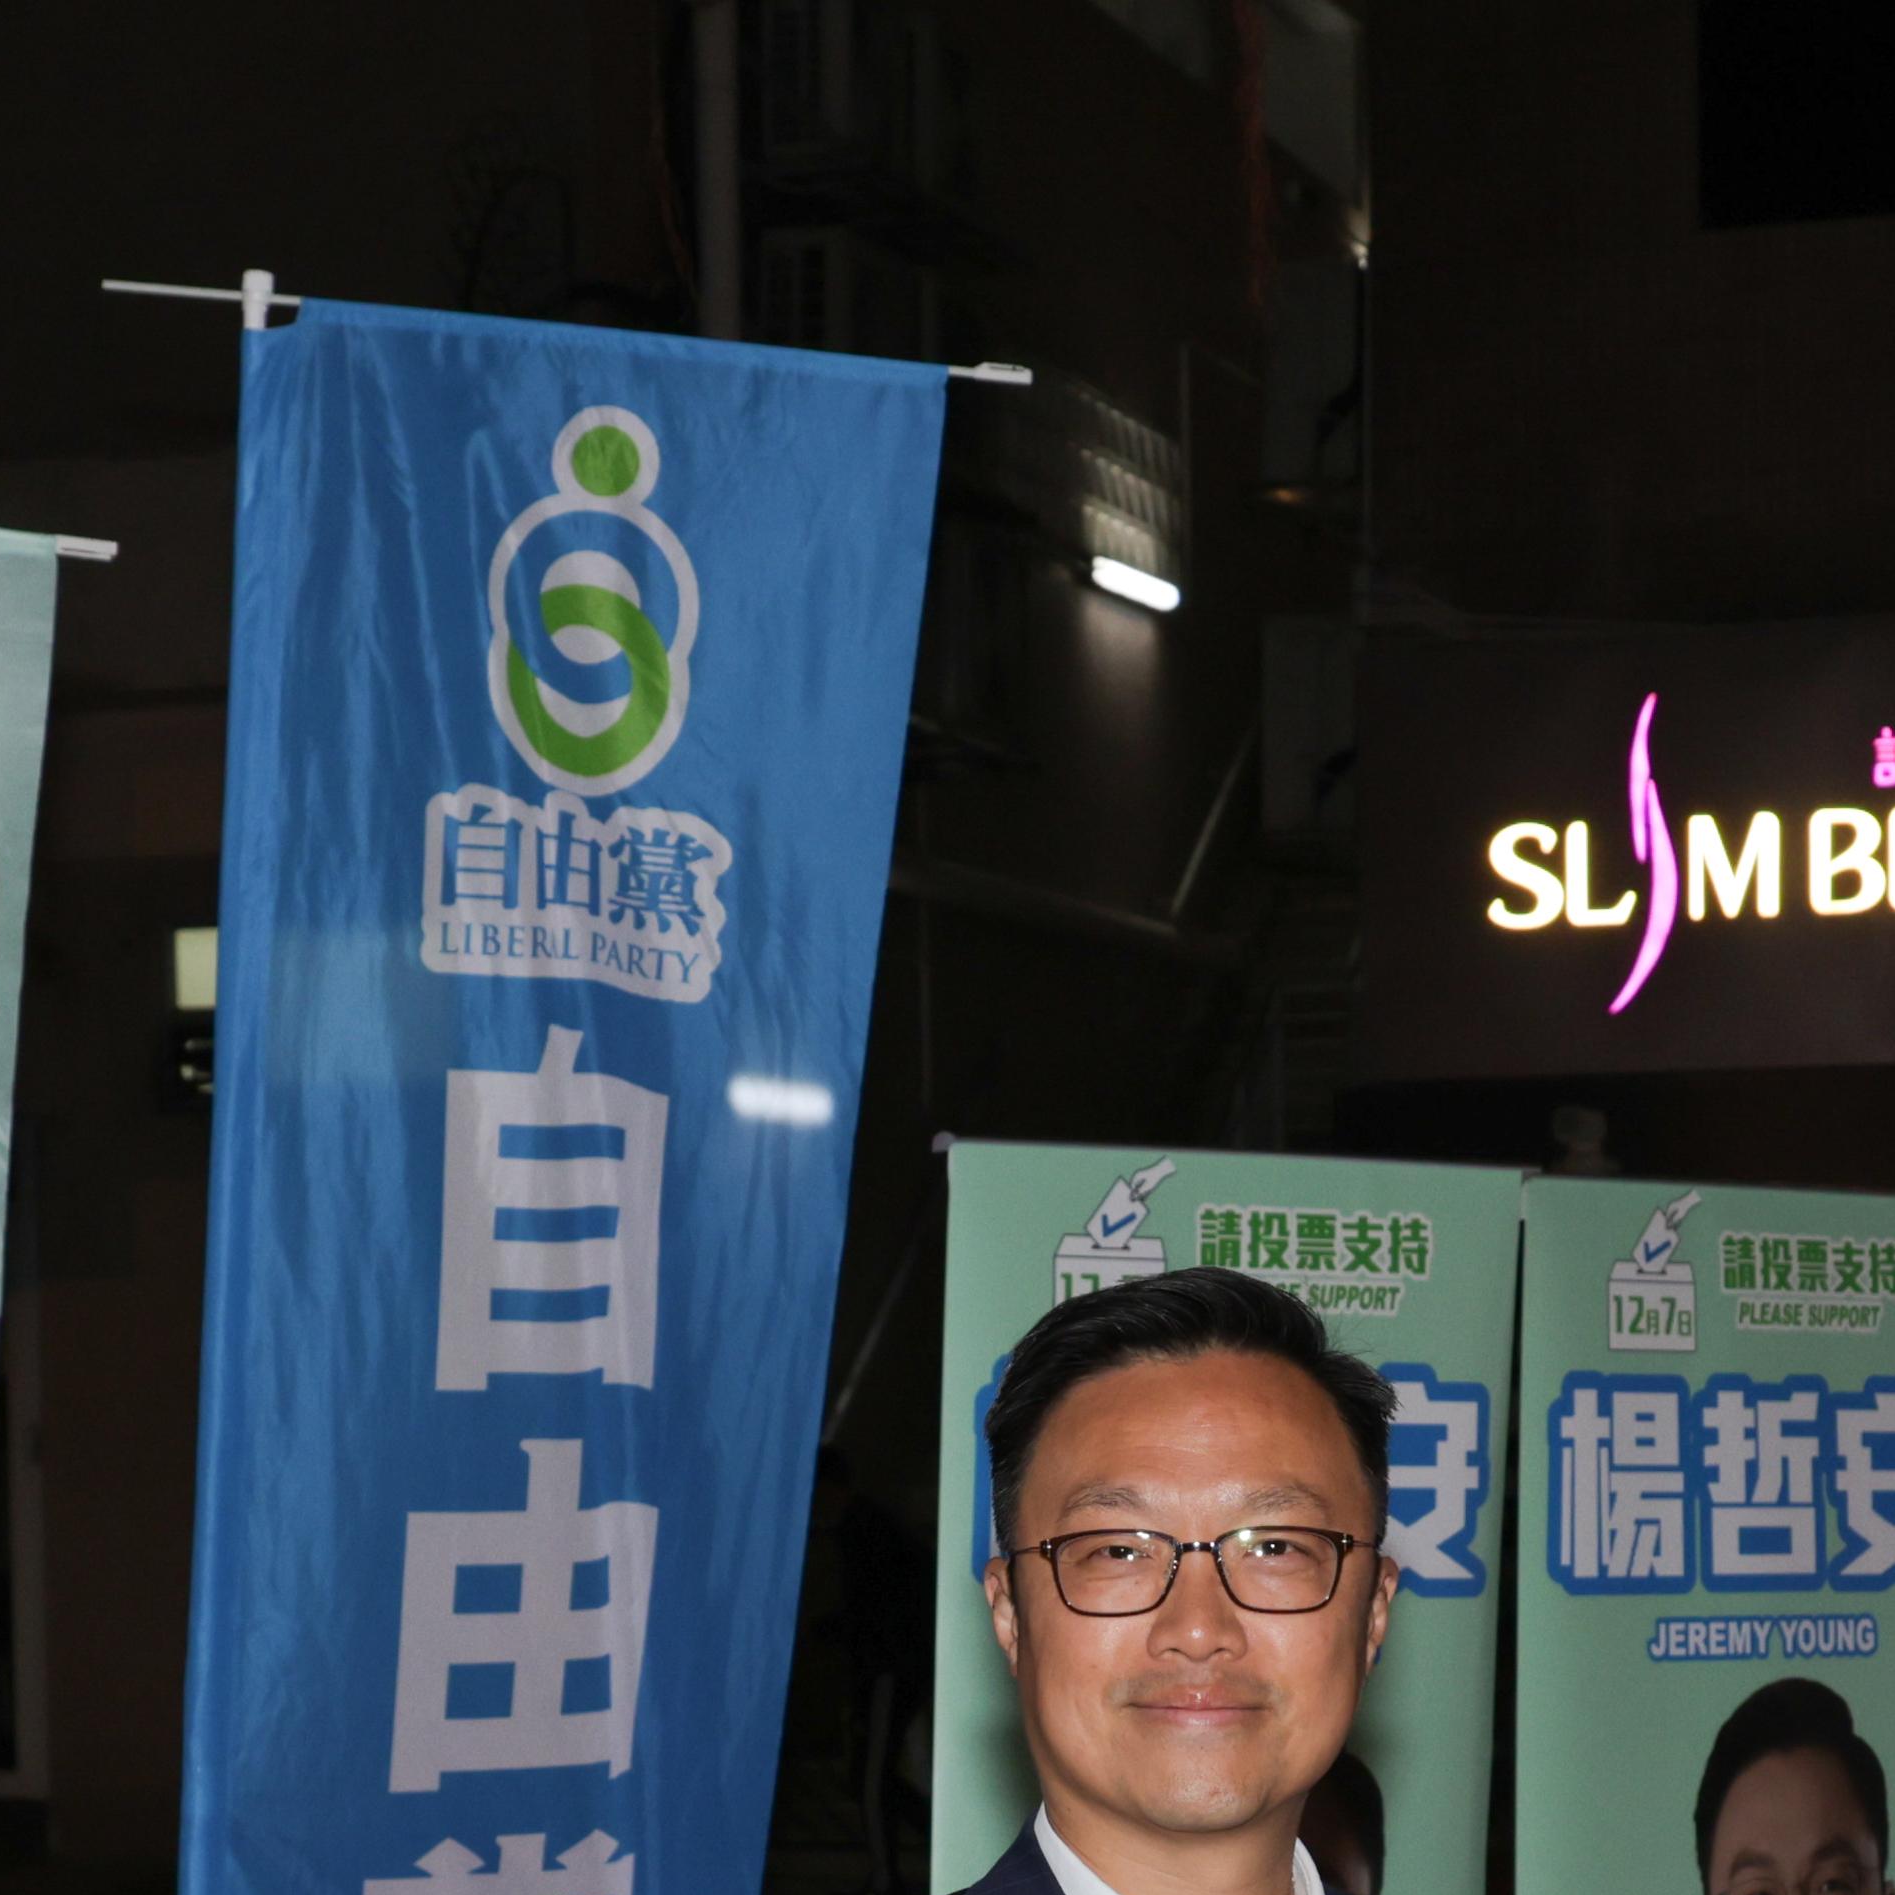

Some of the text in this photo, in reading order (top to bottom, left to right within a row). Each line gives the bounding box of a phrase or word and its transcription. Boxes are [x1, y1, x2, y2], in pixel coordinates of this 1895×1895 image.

[439, 802, 713, 936] 自由黨
[589, 934, 702, 985] PARTY
[1198, 1207, 1431, 1277] 請投票支持
[1305, 1281, 1402, 1312] SUPPORT
[1613, 1295, 1693, 1337] 12月7日
[1737, 1302, 1881, 1329] PLEASE SUPPORT
[1650, 1618, 1877, 1659] JEREMY YOUNG
